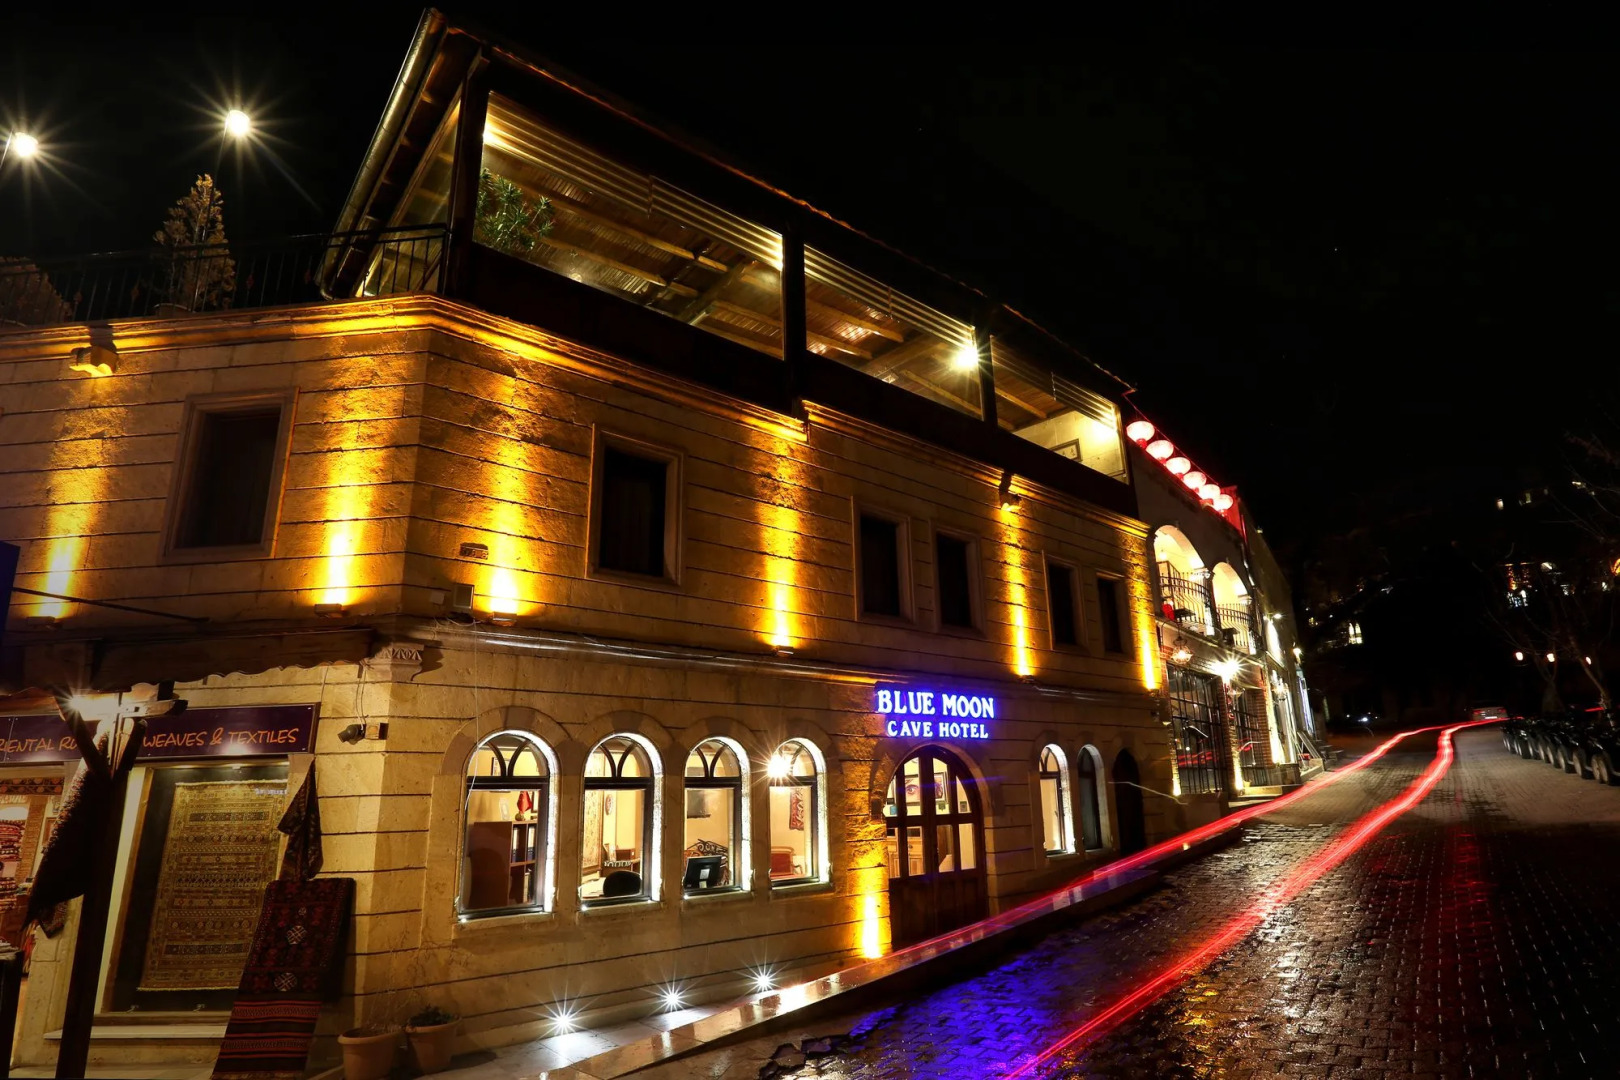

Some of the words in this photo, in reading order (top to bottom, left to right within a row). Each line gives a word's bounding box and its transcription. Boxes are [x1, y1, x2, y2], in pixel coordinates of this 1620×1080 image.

[877, 689, 936, 715] BLUE
[941, 693, 995, 719] MOON
[142, 730, 207, 748] WEAVES
[209, 727, 224, 746] &
[228, 727, 300, 745] TEXTILES
[886, 720, 934, 738] CAVE
[938, 722, 989, 739] HOTEL
